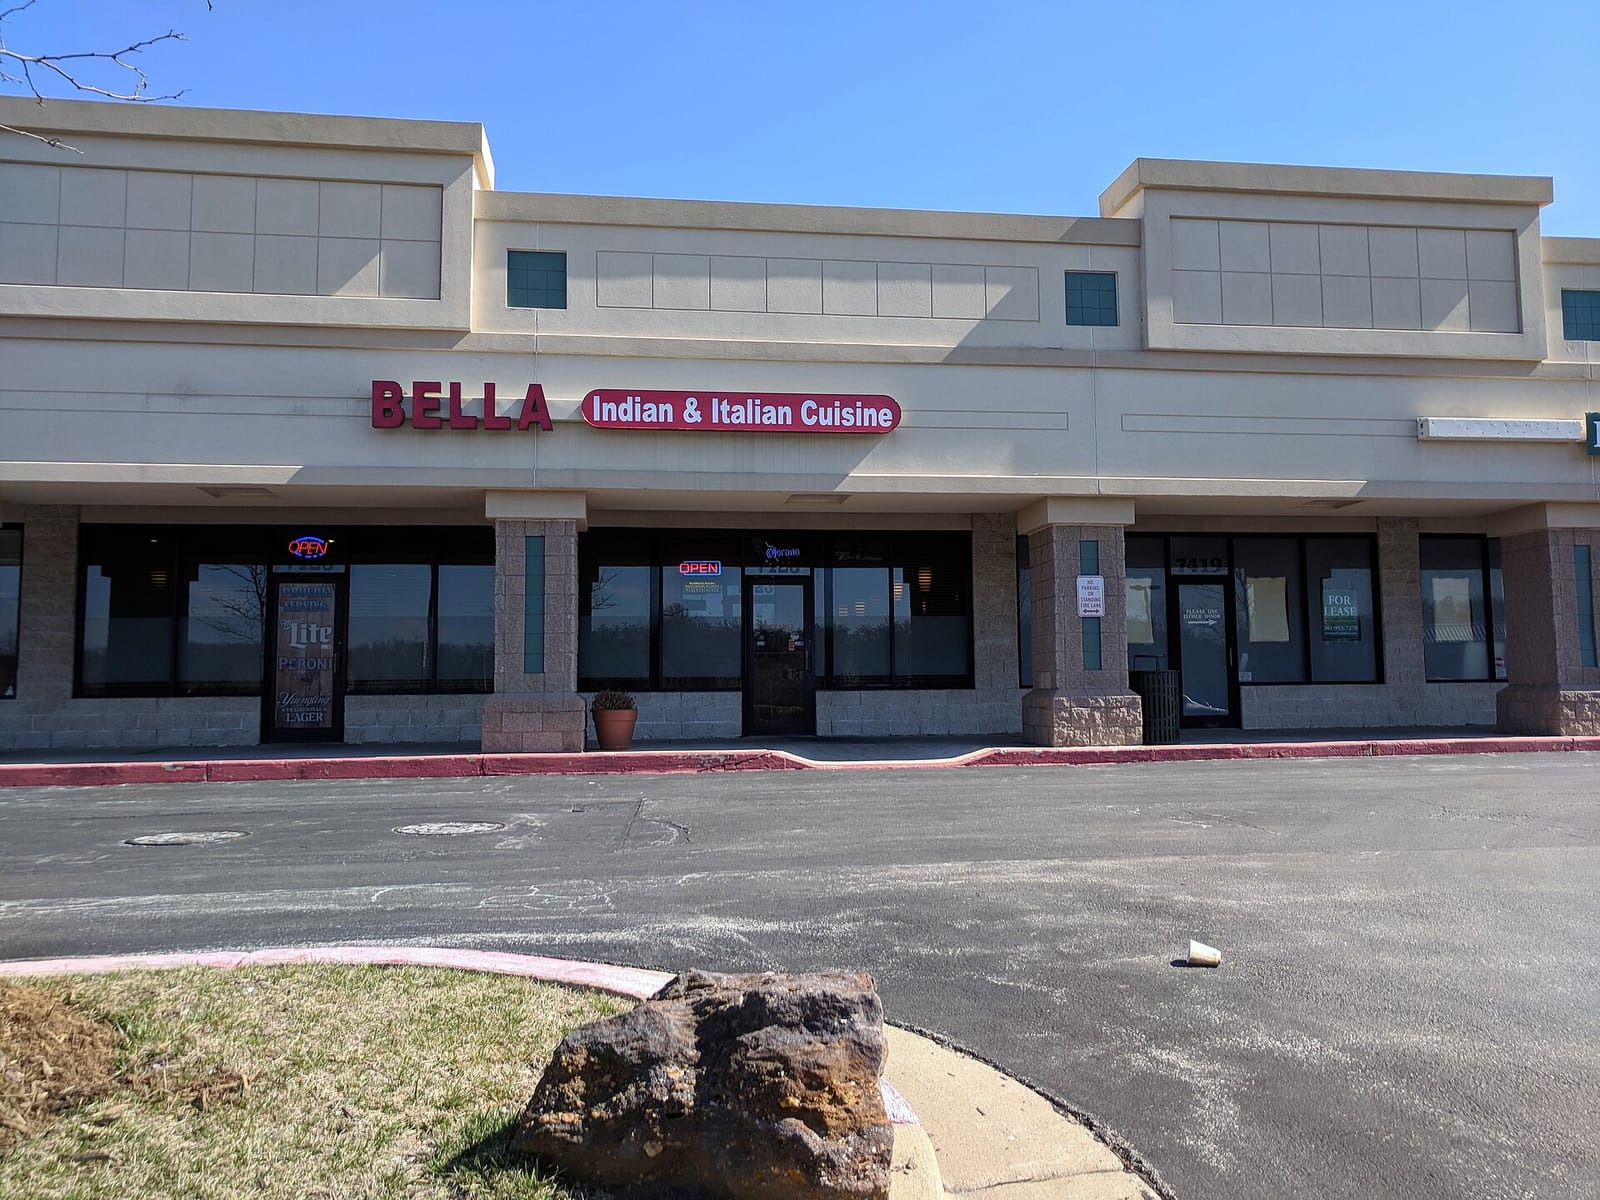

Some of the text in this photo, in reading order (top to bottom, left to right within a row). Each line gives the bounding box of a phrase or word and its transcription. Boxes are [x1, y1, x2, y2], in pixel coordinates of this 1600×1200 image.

[372, 380, 553, 431] BELLA
[593, 396, 893, 427] Indian & Italian Cuisine
[288, 541, 328, 555] OPEN
[765, 547, 800, 558] Corona
[680, 563, 718, 573] OPEN
[1176, 558, 1222, 574] 7419
[1328, 595, 1352, 605] FOR
[1324, 606, 1357, 617] LEASE
[289, 623, 332, 649] Lite
[278, 656, 334, 671] PERONI
[278, 690, 330, 708] Yuengling
[286, 712, 323, 722] LAGER
